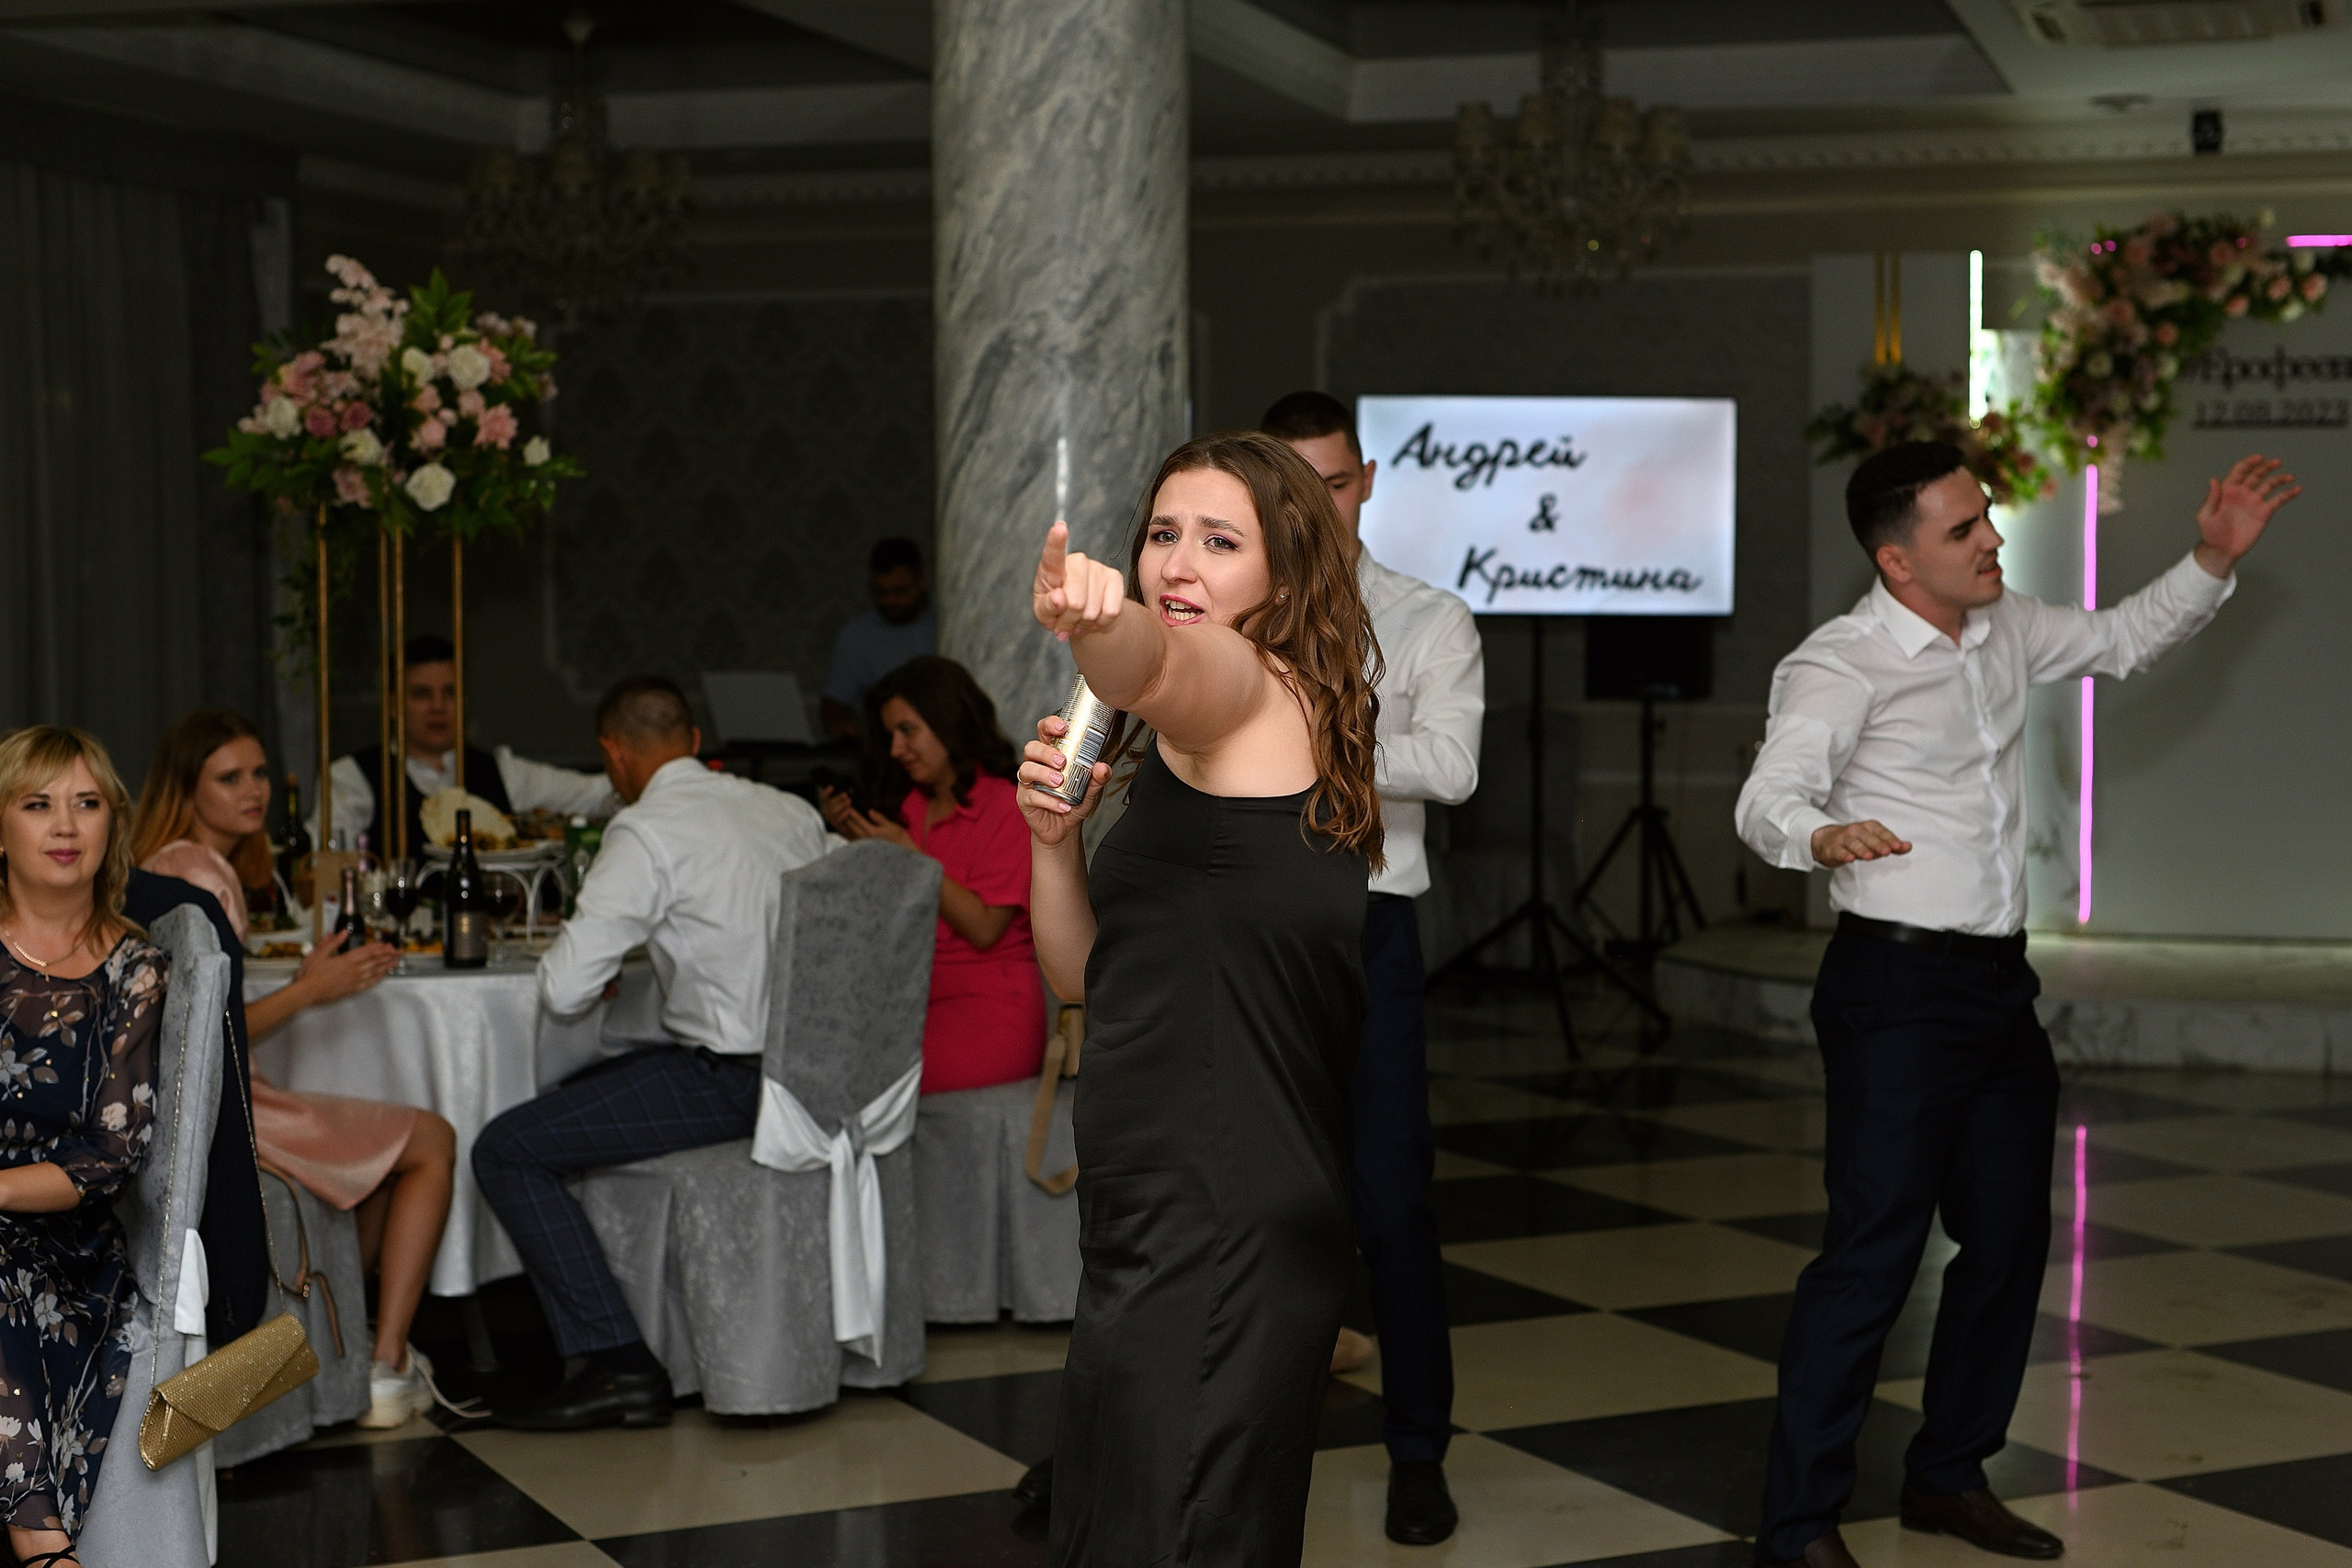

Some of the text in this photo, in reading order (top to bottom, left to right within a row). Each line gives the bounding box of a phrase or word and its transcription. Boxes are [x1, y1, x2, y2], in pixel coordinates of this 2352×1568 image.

[1390, 422, 1588, 491] Андрей
[1528, 493, 1560, 532] &
[1458, 547, 1702, 604] Кристина
